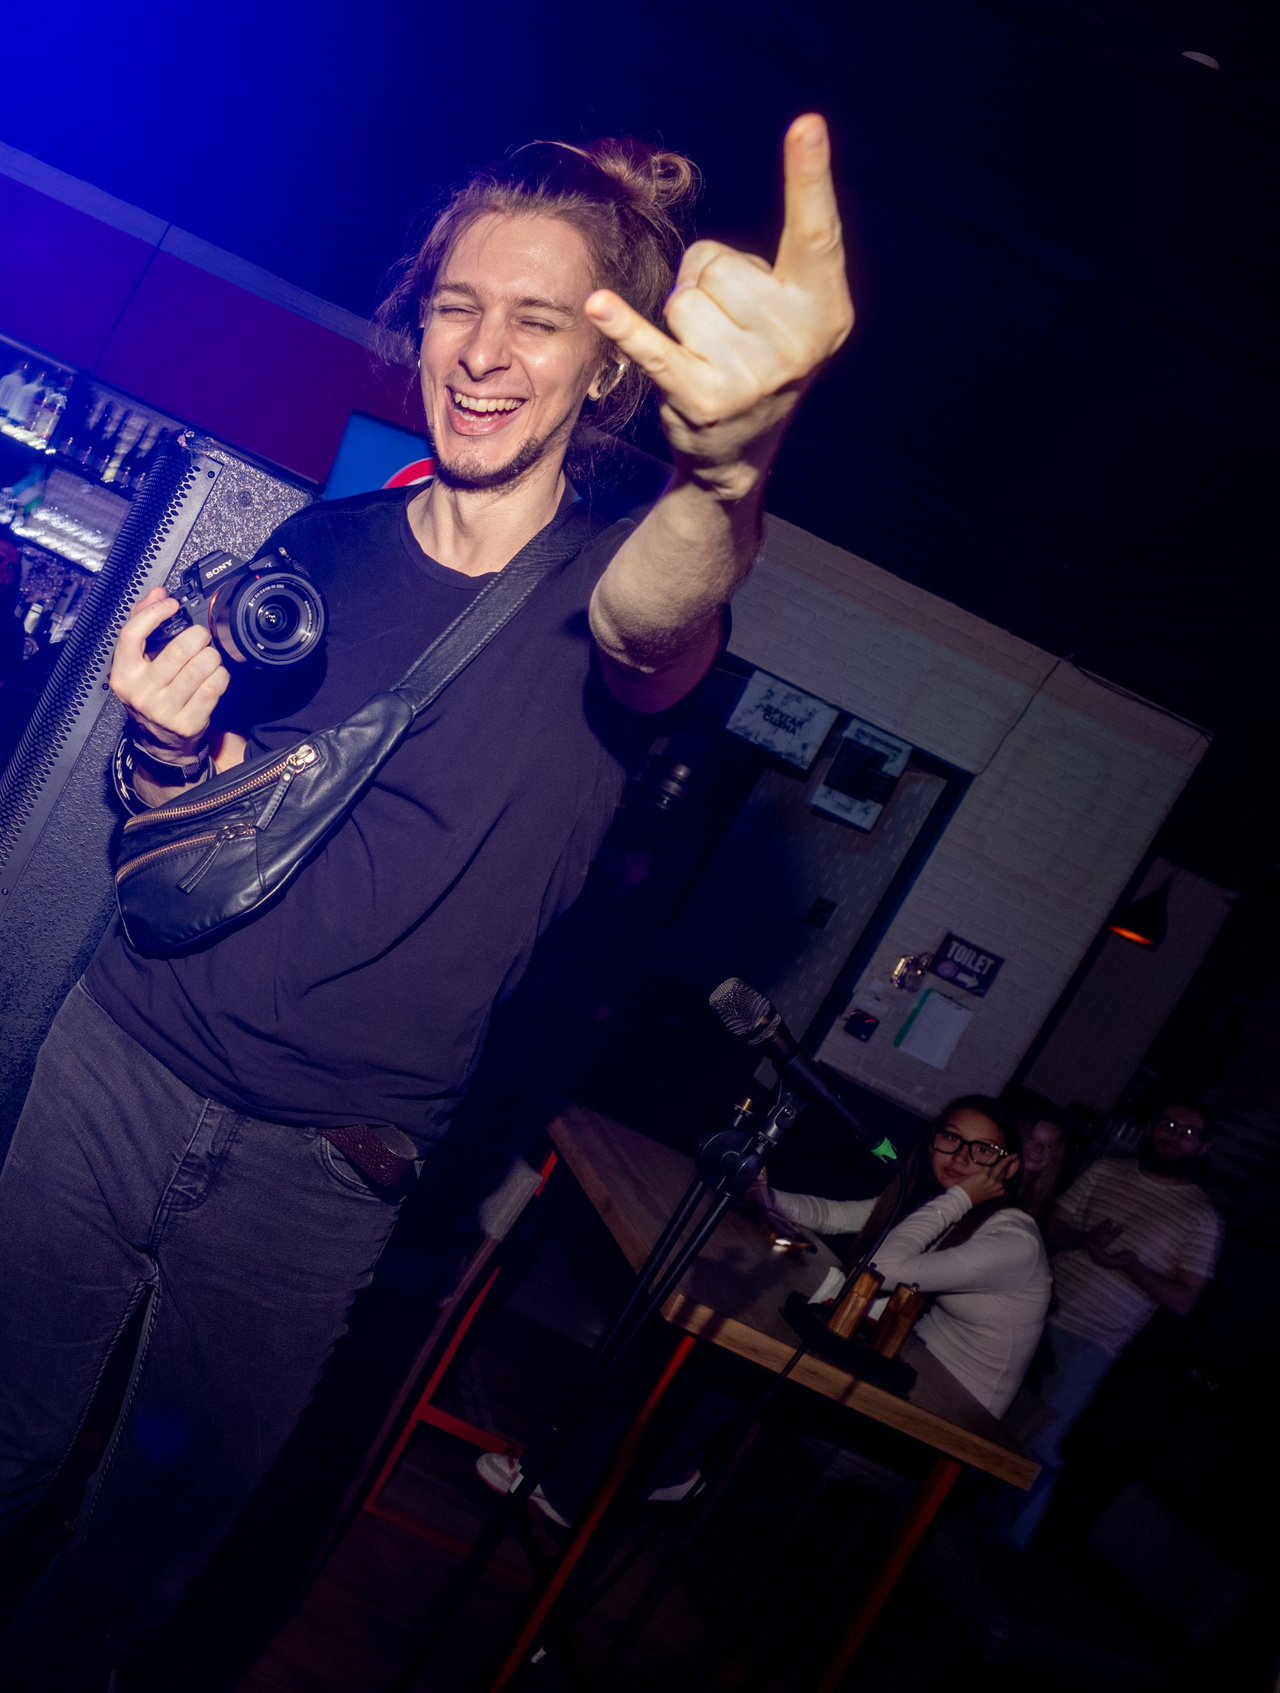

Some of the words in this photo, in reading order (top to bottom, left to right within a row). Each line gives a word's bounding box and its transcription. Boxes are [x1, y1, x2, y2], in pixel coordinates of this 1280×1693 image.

[205, 559, 233, 579] SONY
[761, 711, 798, 736] СЦЕНА
[762, 704, 805, 729] ДРУГАЯ
[946, 940, 996, 976] TOILET
